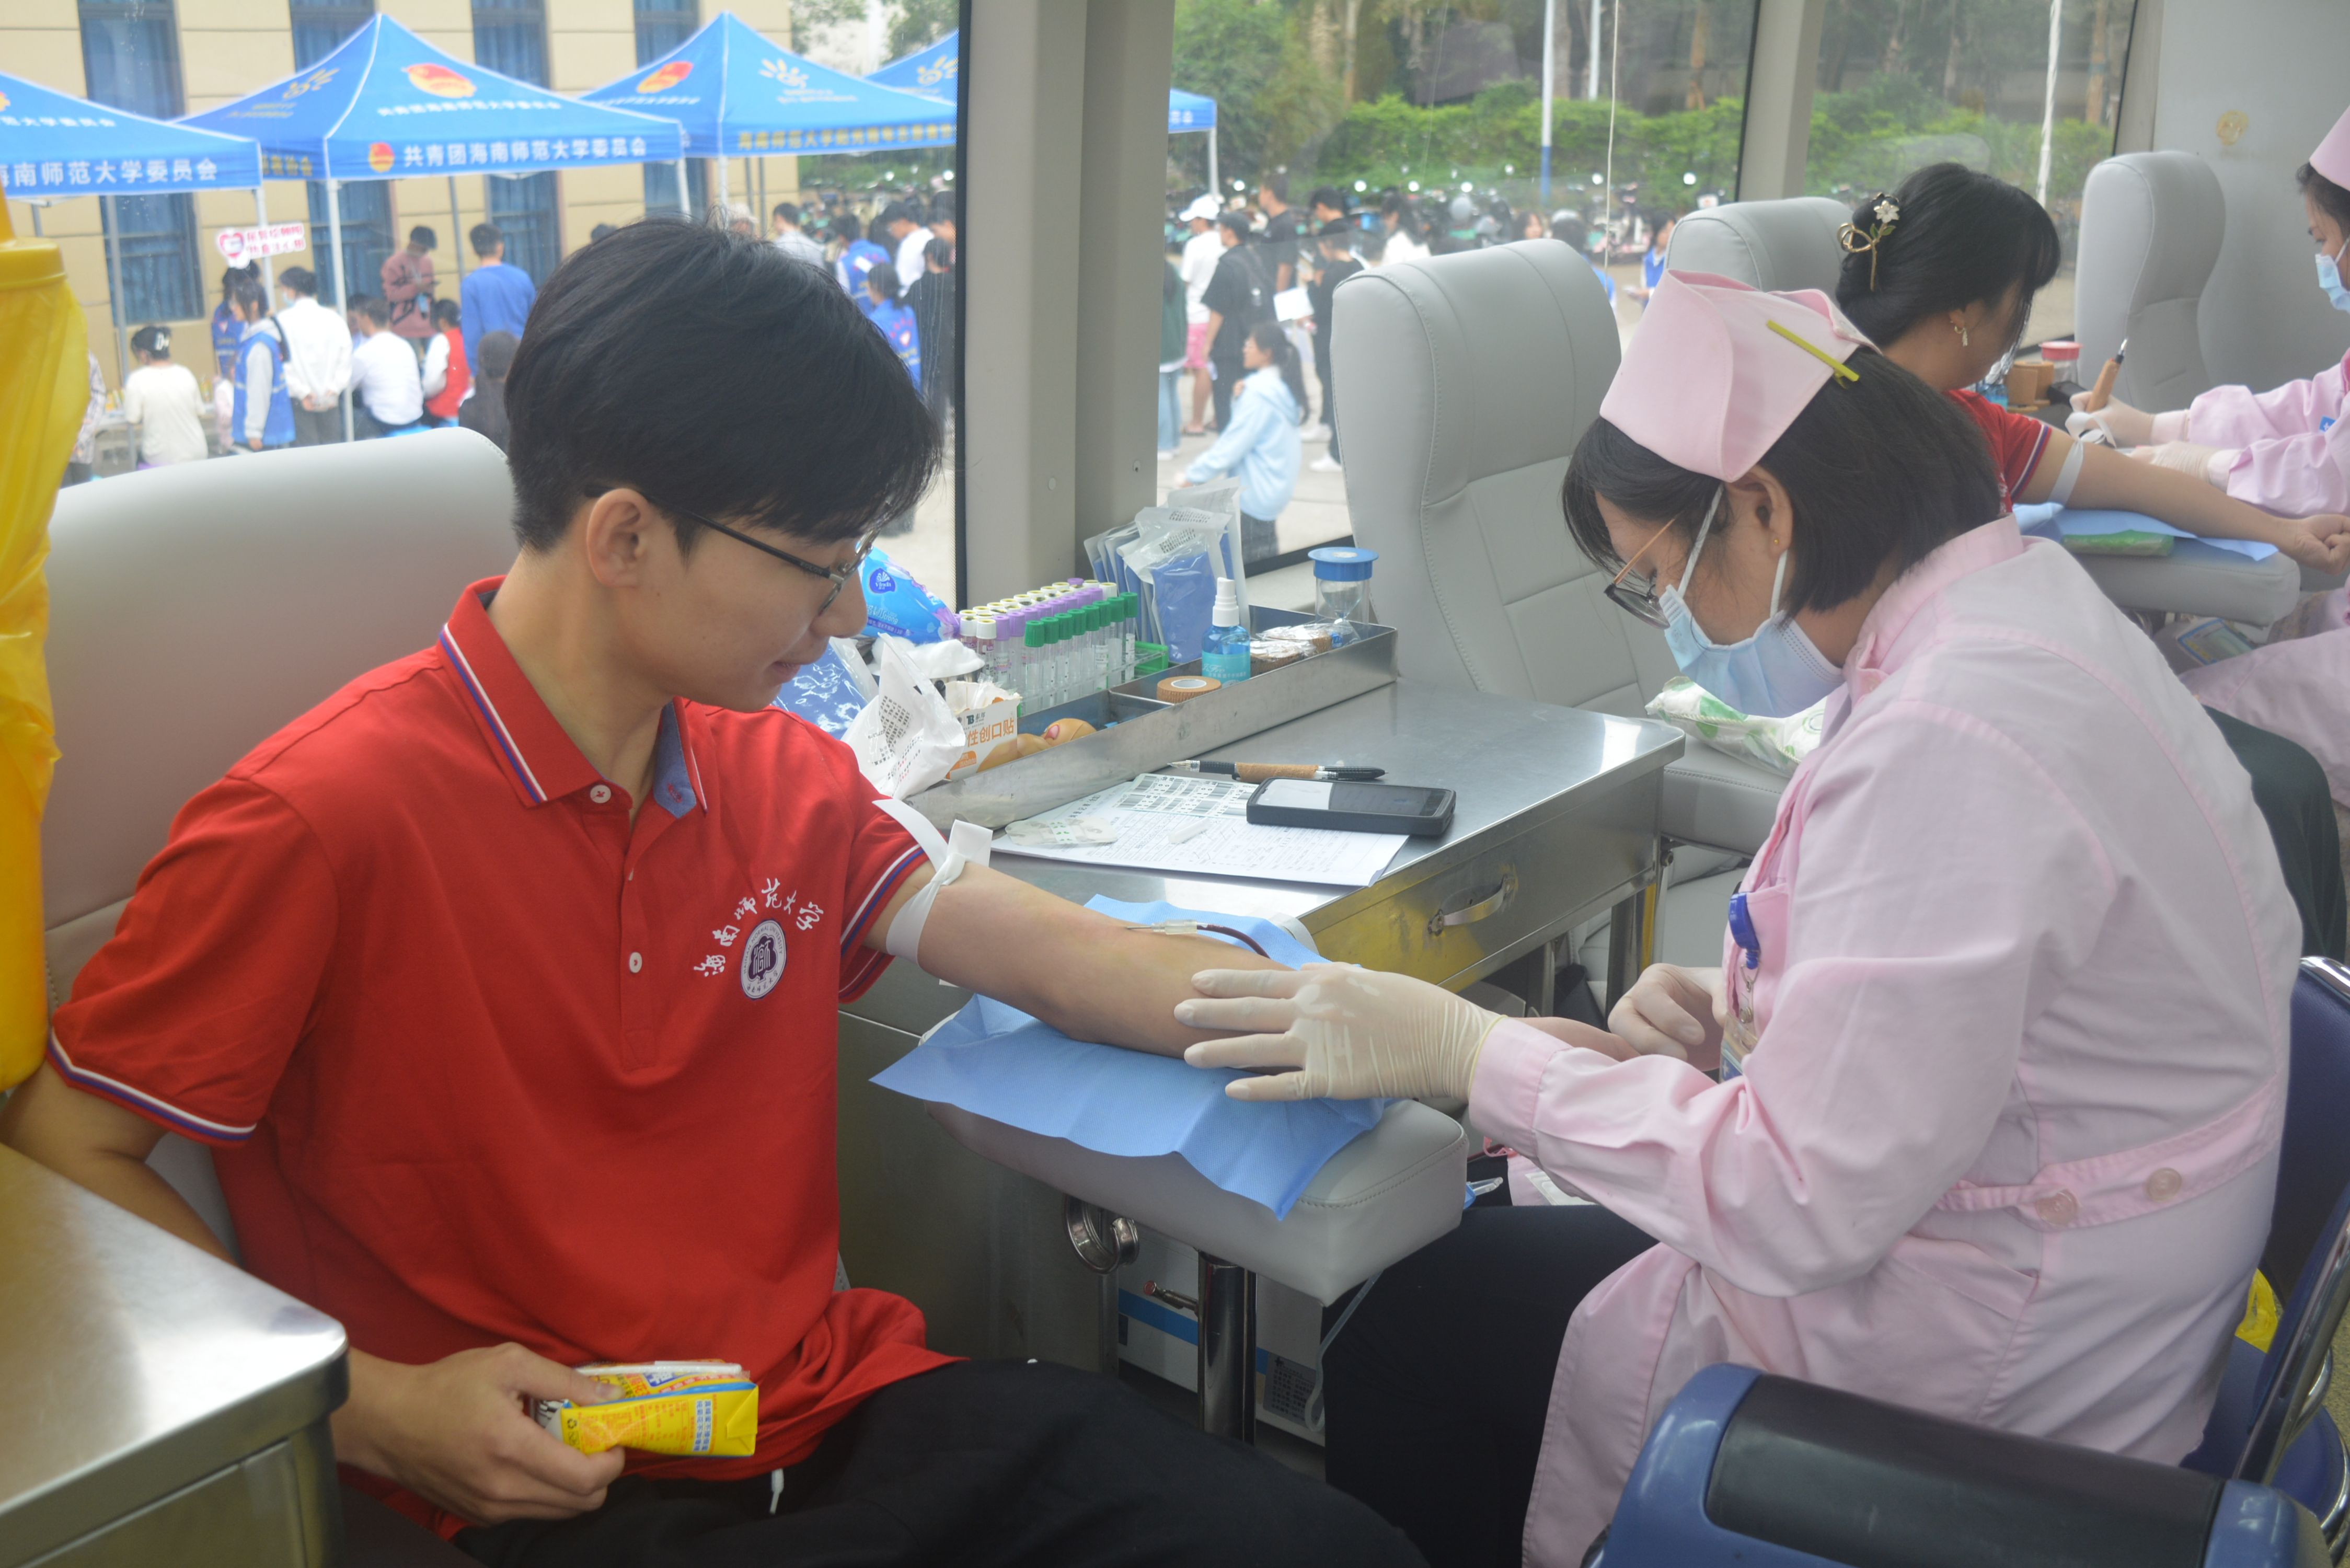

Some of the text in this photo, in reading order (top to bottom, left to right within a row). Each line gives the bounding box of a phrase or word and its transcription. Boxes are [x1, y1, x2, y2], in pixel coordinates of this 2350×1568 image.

[404, 136, 647, 168] 共青团海南师范大学委员会
[694, 878, 824, 977] 海南师范大学
[751, 926, 769, 943] NORMAL
[769, 926, 784, 954] UNIVERSITY
